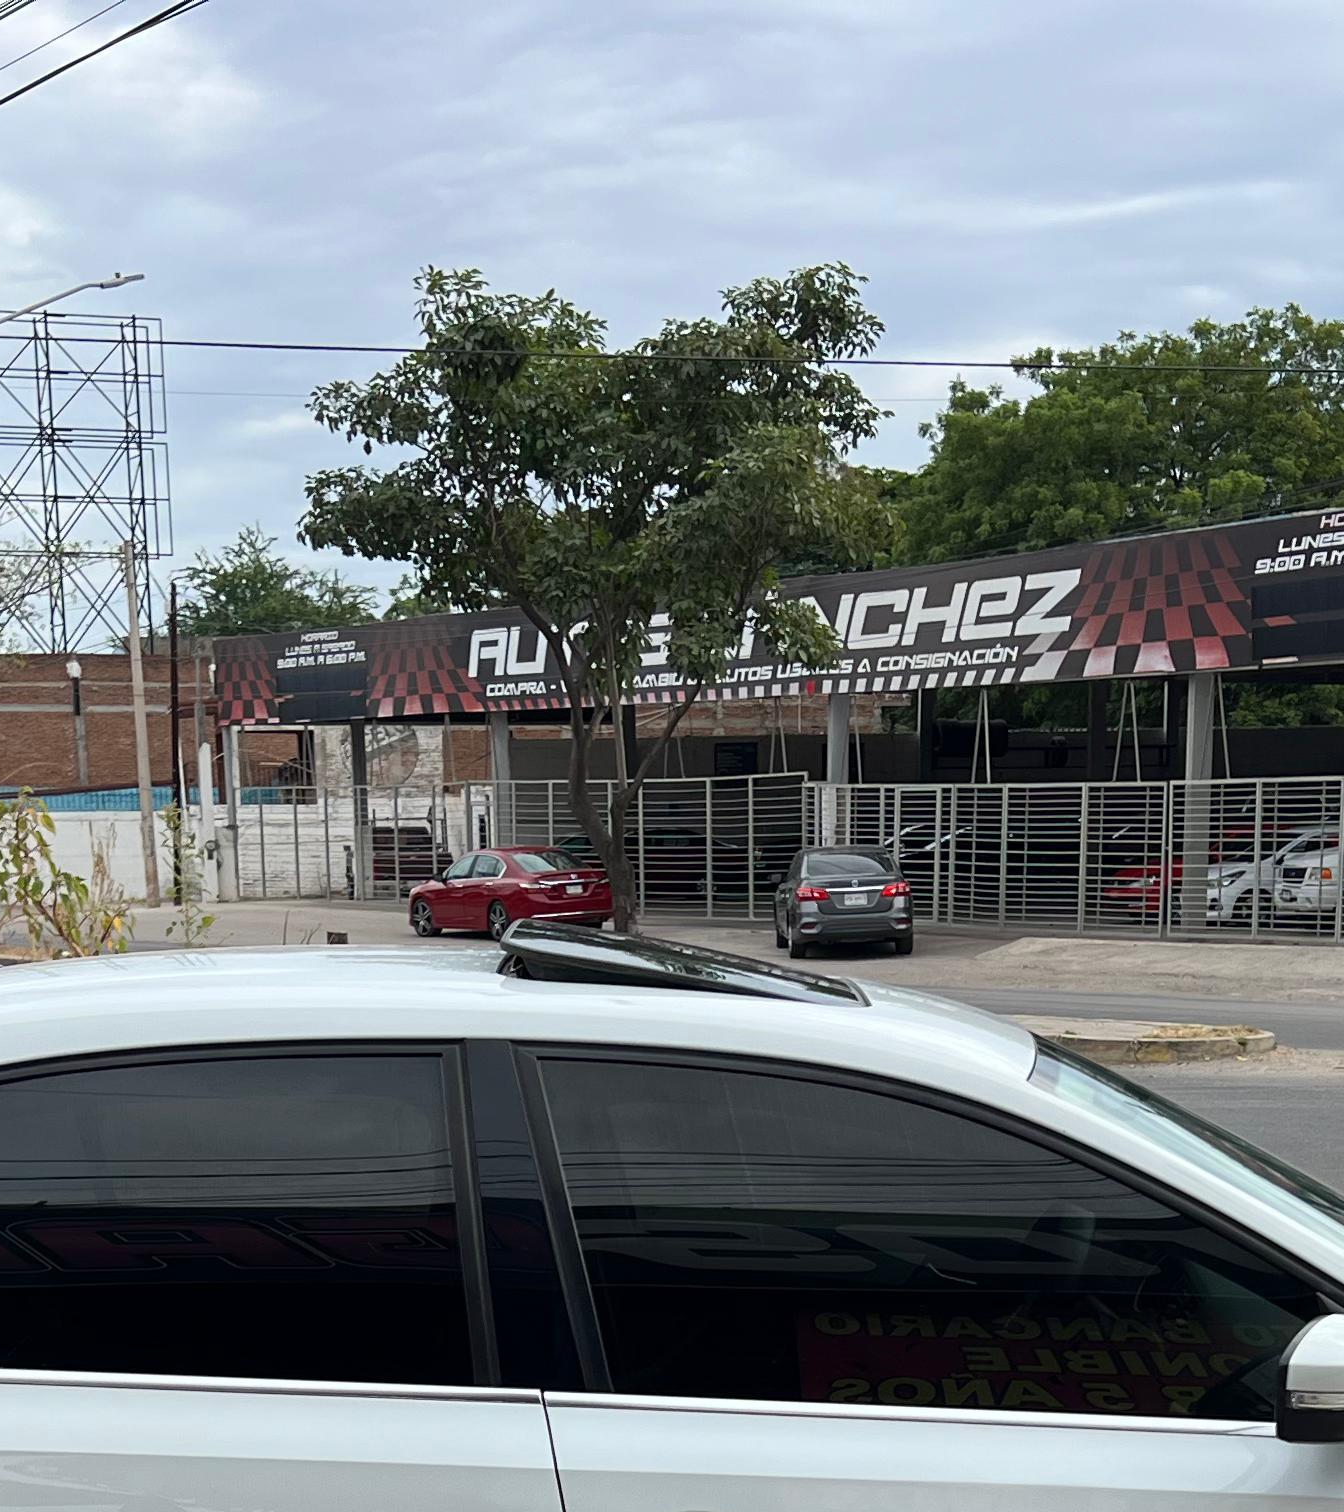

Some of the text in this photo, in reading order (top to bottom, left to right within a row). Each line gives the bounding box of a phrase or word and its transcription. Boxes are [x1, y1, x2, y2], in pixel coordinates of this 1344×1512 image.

[1254, 553, 1306, 575] 9:00
[857, 658, 871, 673] A
[876, 643, 1019, 671] CONSIGNACIÓN
[485, 681, 547, 698] COMPRA
